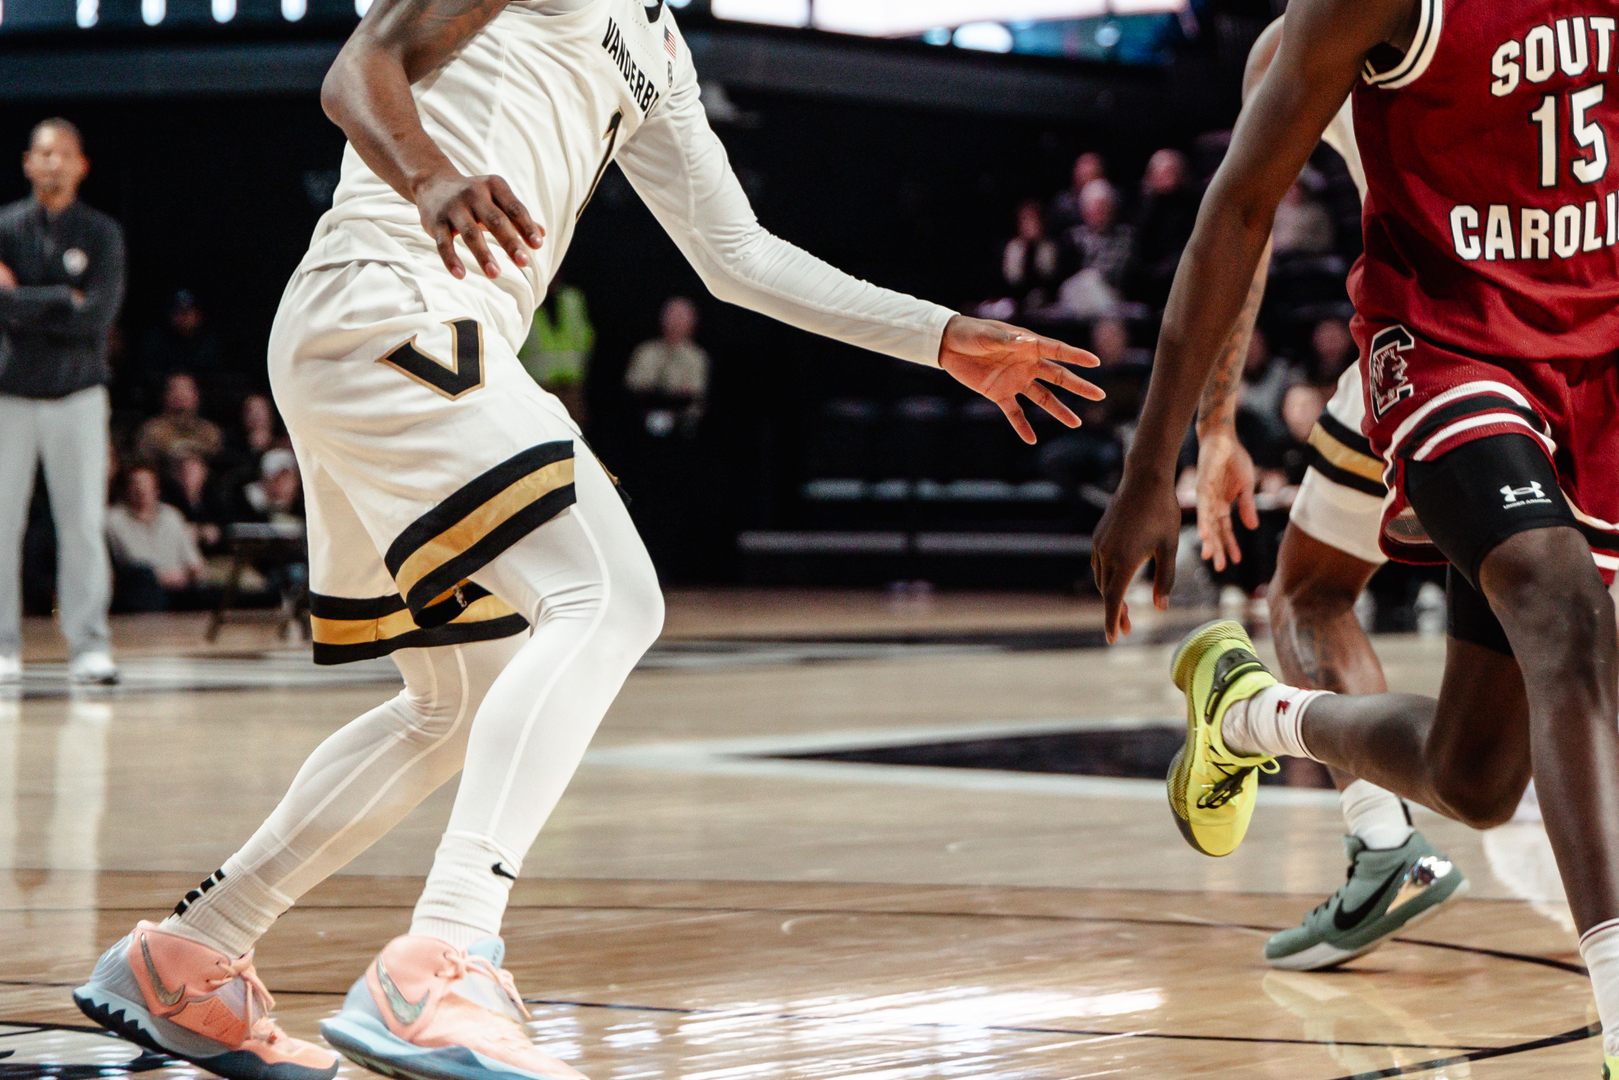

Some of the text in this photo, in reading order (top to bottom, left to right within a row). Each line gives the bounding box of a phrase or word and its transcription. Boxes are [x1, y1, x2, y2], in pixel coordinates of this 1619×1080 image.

[1531, 83, 1609, 189] 15
[375, 317, 486, 402] V
[1503, 500, 1526, 509] UNDER
